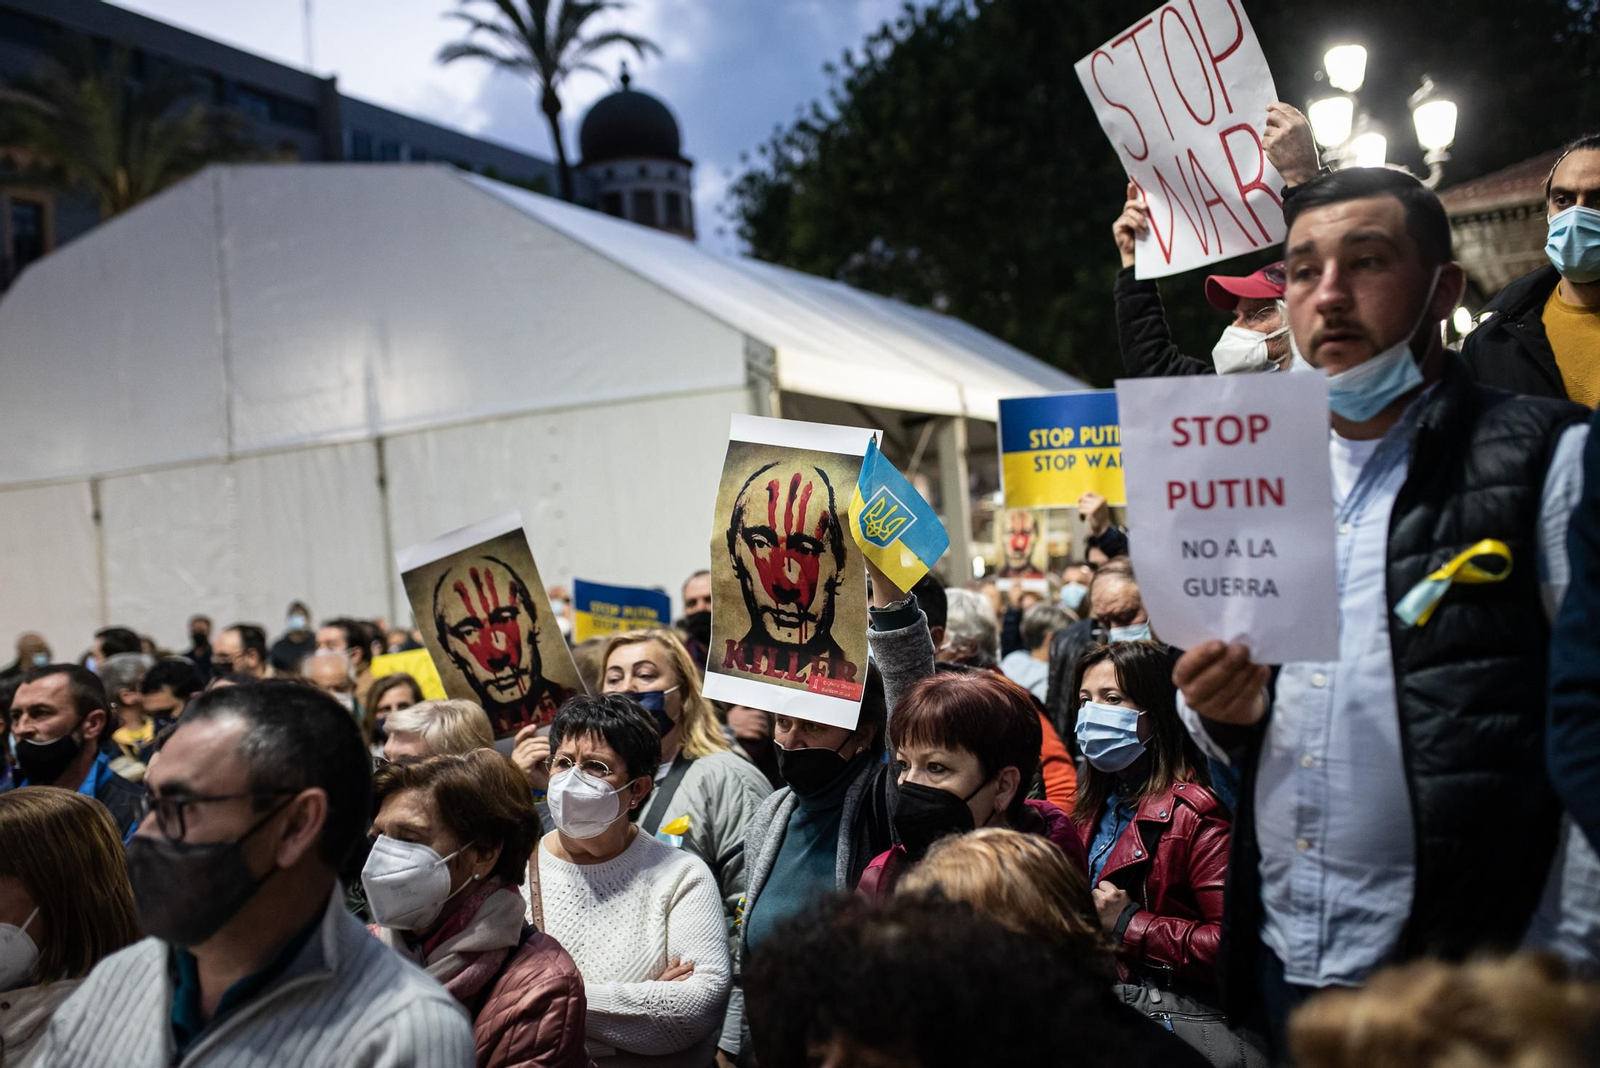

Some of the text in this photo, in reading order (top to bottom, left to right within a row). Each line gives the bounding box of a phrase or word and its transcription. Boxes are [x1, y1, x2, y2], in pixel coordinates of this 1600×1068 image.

[1091, 0, 1244, 162] STOP
[1130, 123, 1283, 265] WAR
[1028, 425, 1122, 449] STOP PUTI
[1171, 414, 1271, 447] STOP
[1034, 453, 1122, 472] STOP WA
[1166, 477, 1286, 510] PUTIN
[1182, 538, 1277, 559] NO A LA
[1183, 577, 1279, 598] GUERRA
[721, 638, 858, 685] KILLER
